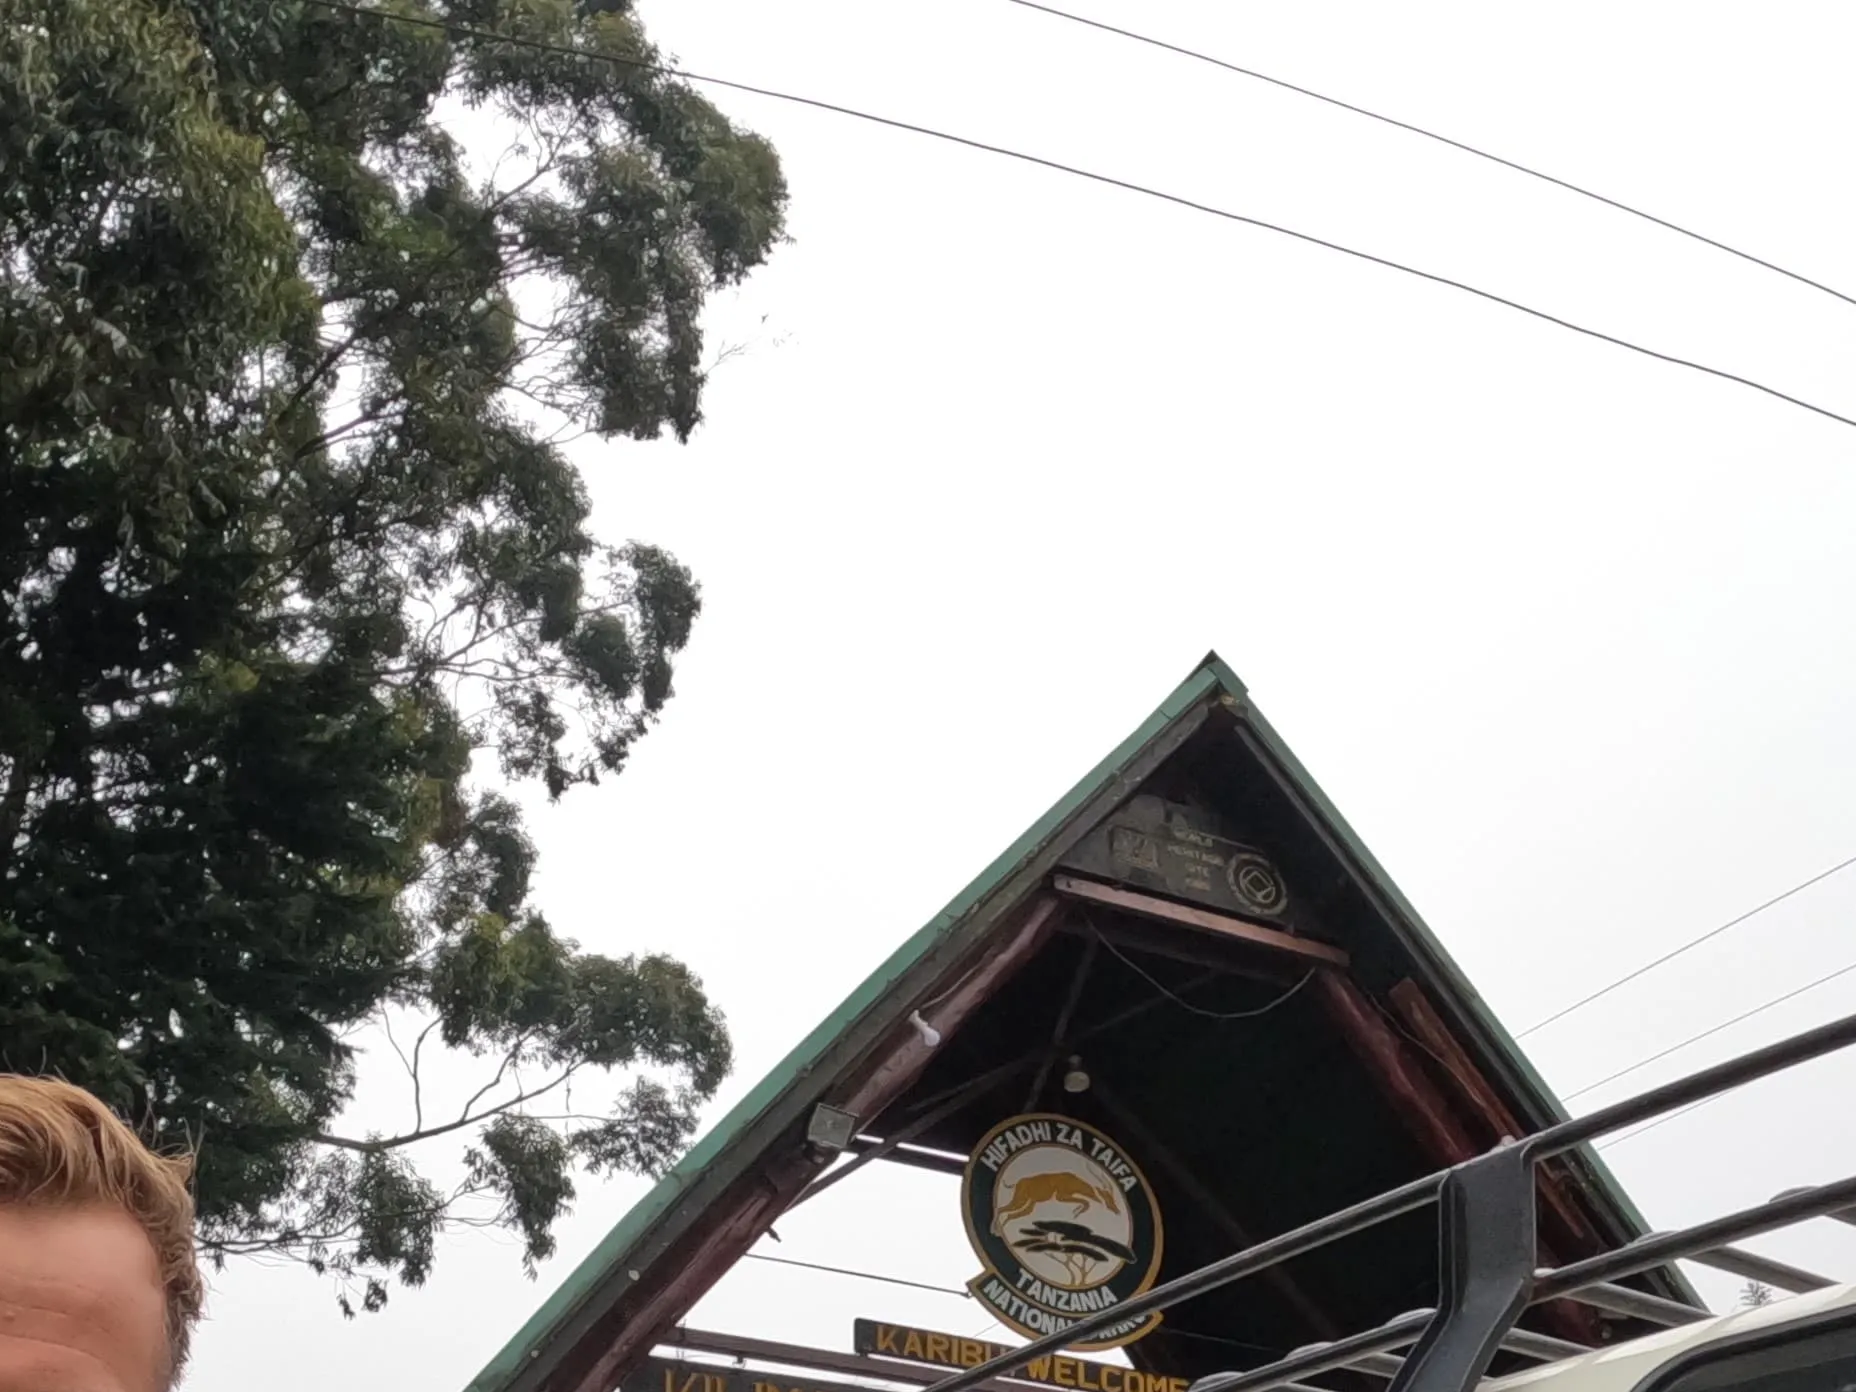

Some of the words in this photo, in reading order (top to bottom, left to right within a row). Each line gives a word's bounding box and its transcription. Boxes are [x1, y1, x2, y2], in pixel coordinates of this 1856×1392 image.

[980, 1121, 1051, 1171] HIFADHI
[1056, 1123, 1084, 1150] ZA
[1092, 1138, 1137, 1192] TAIFA
[1016, 1269, 1117, 1311] TANZANIA
